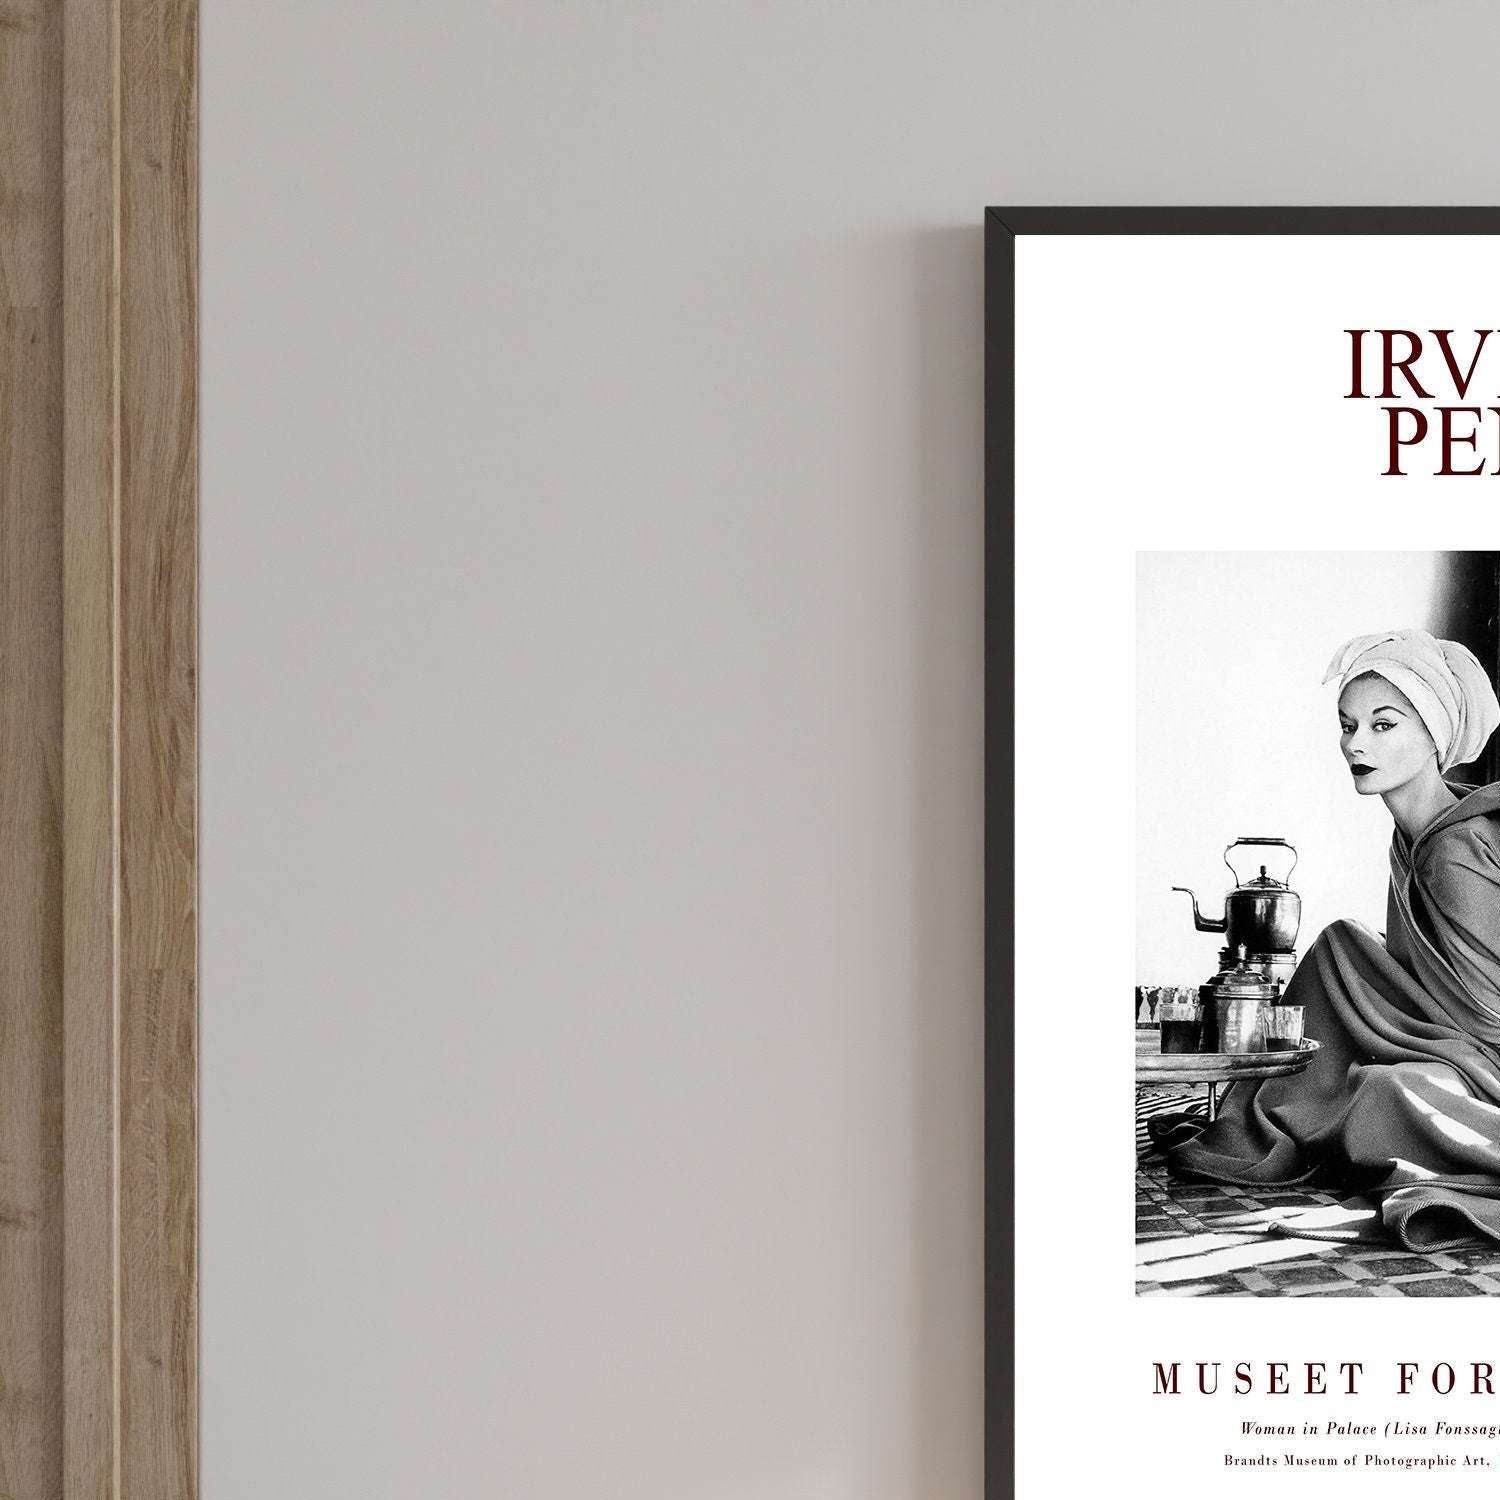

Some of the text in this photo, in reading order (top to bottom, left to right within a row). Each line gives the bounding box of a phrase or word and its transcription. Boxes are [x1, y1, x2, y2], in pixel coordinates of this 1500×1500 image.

[1152, 1362, 1364, 1395] MUSEET
[1396, 1361, 1496, 1395] FOR
[1241, 1421, 1295, 1436] Woman
[1302, 1421, 1318, 1436] in
[1326, 1421, 1377, 1436] Palace
[1384, 1421, 1427, 1438] (Lisa
[1224, 1454, 1278, 1466] Brandts
[1284, 1454, 1338, 1467] Museum
[1343, 1454, 1358, 1466] of
[1364, 1454, 1457, 1470] Photographic
[1462, 1454, 1490, 1468] Art,
